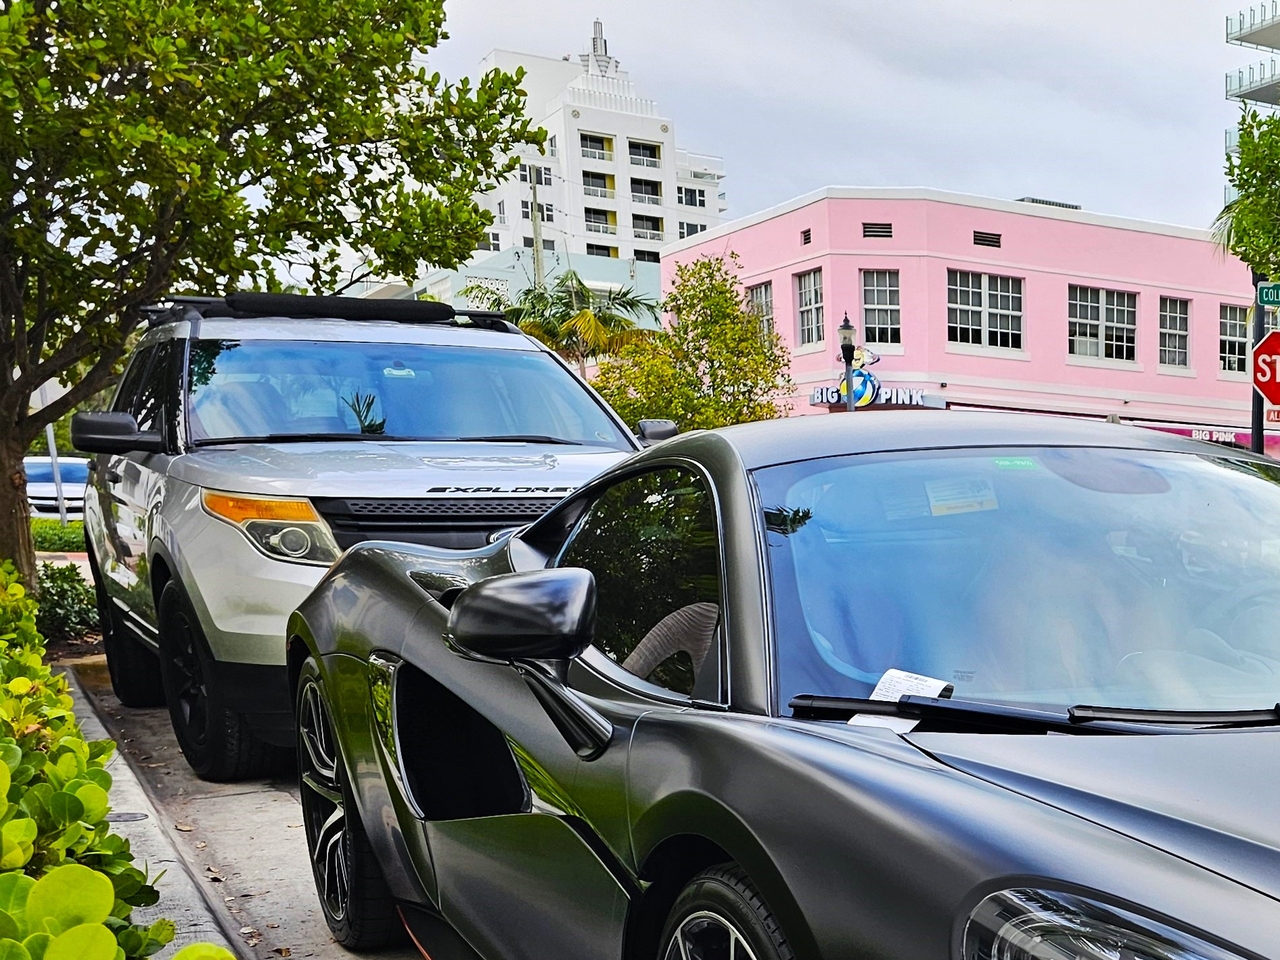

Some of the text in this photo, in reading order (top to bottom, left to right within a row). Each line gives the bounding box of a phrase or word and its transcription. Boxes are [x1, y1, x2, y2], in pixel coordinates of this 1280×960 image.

[814, 386, 924, 405] BIG PINK
[1192, 429, 1235, 442] BIG PINK
